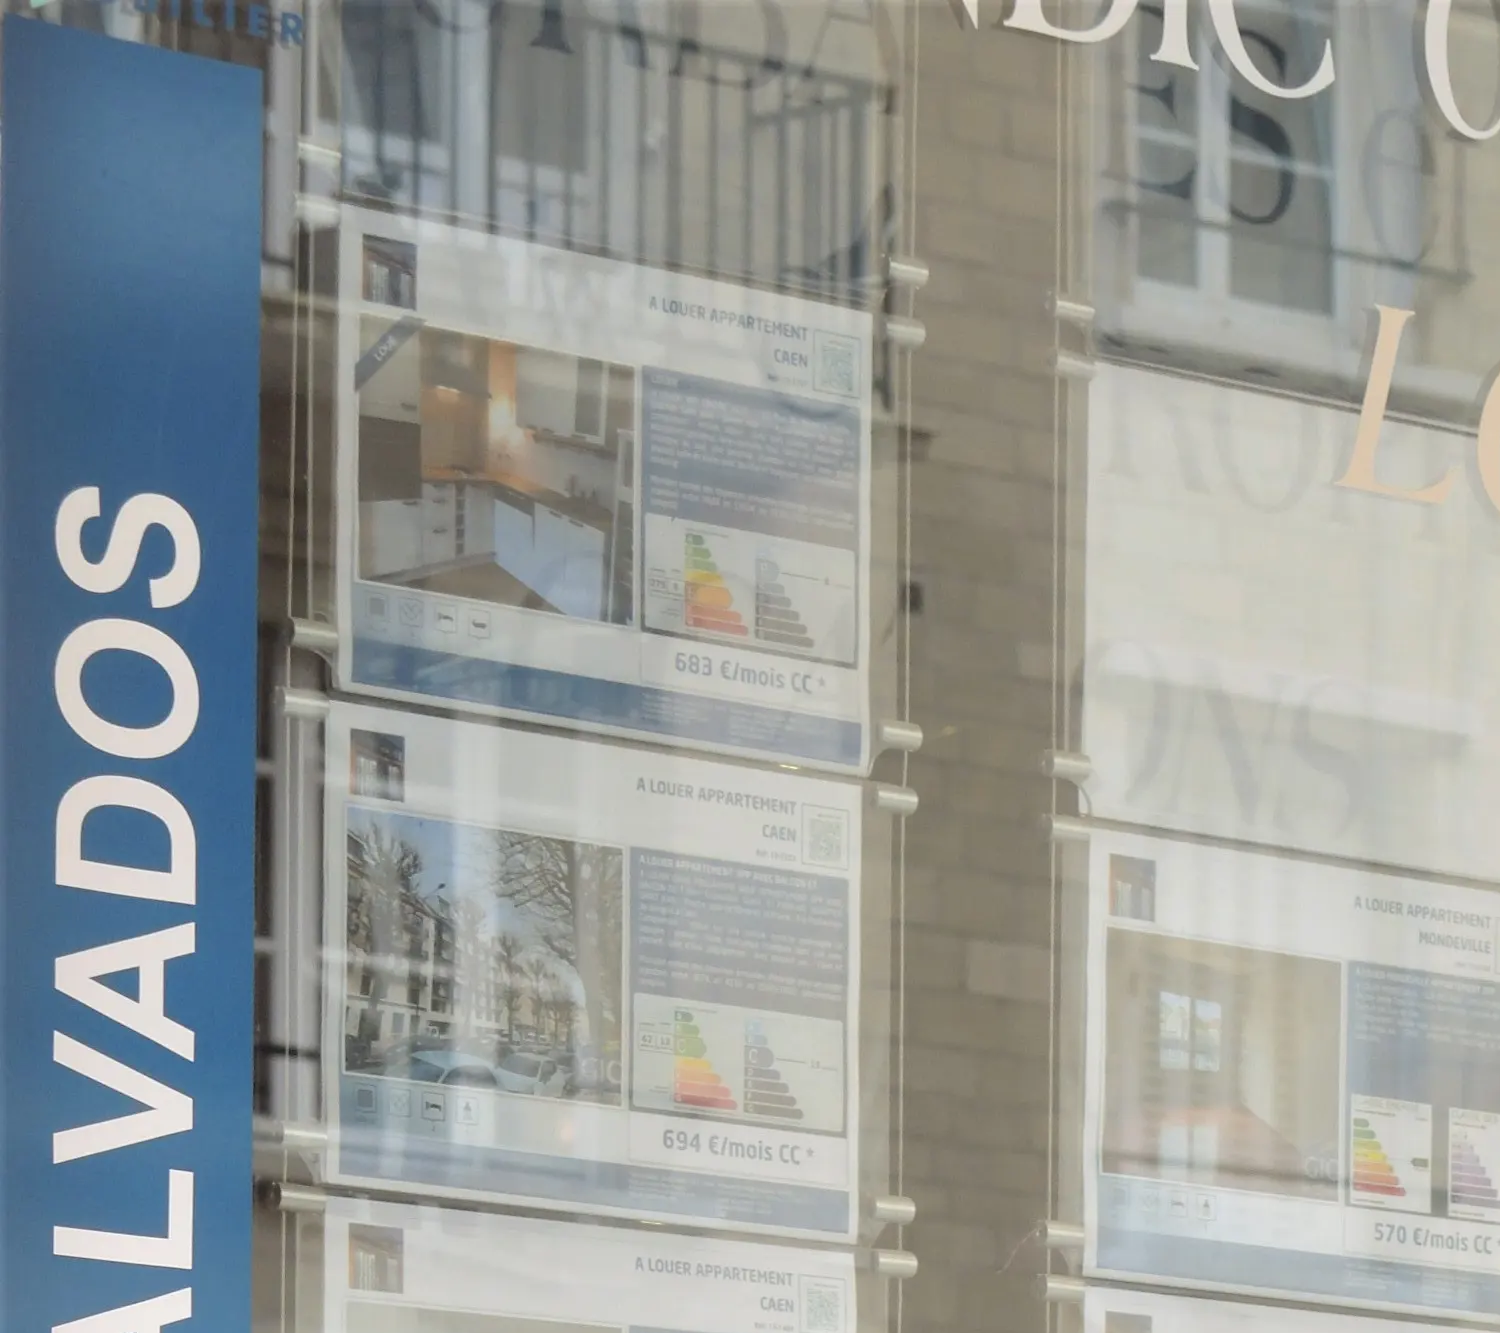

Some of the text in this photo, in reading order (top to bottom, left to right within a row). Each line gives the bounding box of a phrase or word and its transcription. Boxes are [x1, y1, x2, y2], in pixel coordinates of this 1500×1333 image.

[662, 299, 706, 321] LOUER
[710, 308, 808, 341] APPARTEMENT
[773, 348, 808, 368] CAEN
[674, 652, 813, 694] 683 €/mois CC
[650, 779, 694, 800] LOUER
[698, 786, 797, 816] APPARTEMENT
[762, 824, 797, 843] CAEN
[1365, 898, 1404, 916] LOUER
[1406, 904, 1492, 930] APPARTEMENT
[1418, 930, 1492, 954] MONDEVILLE
[662, 1129, 800, 1165] 694 €/mois CC
[1374, 1223, 1492, 1255] 570 €/mois CC
[635, 1257, 794, 1286] A LOUER APPARTEMENT
[760, 1296, 794, 1313] CAEN
